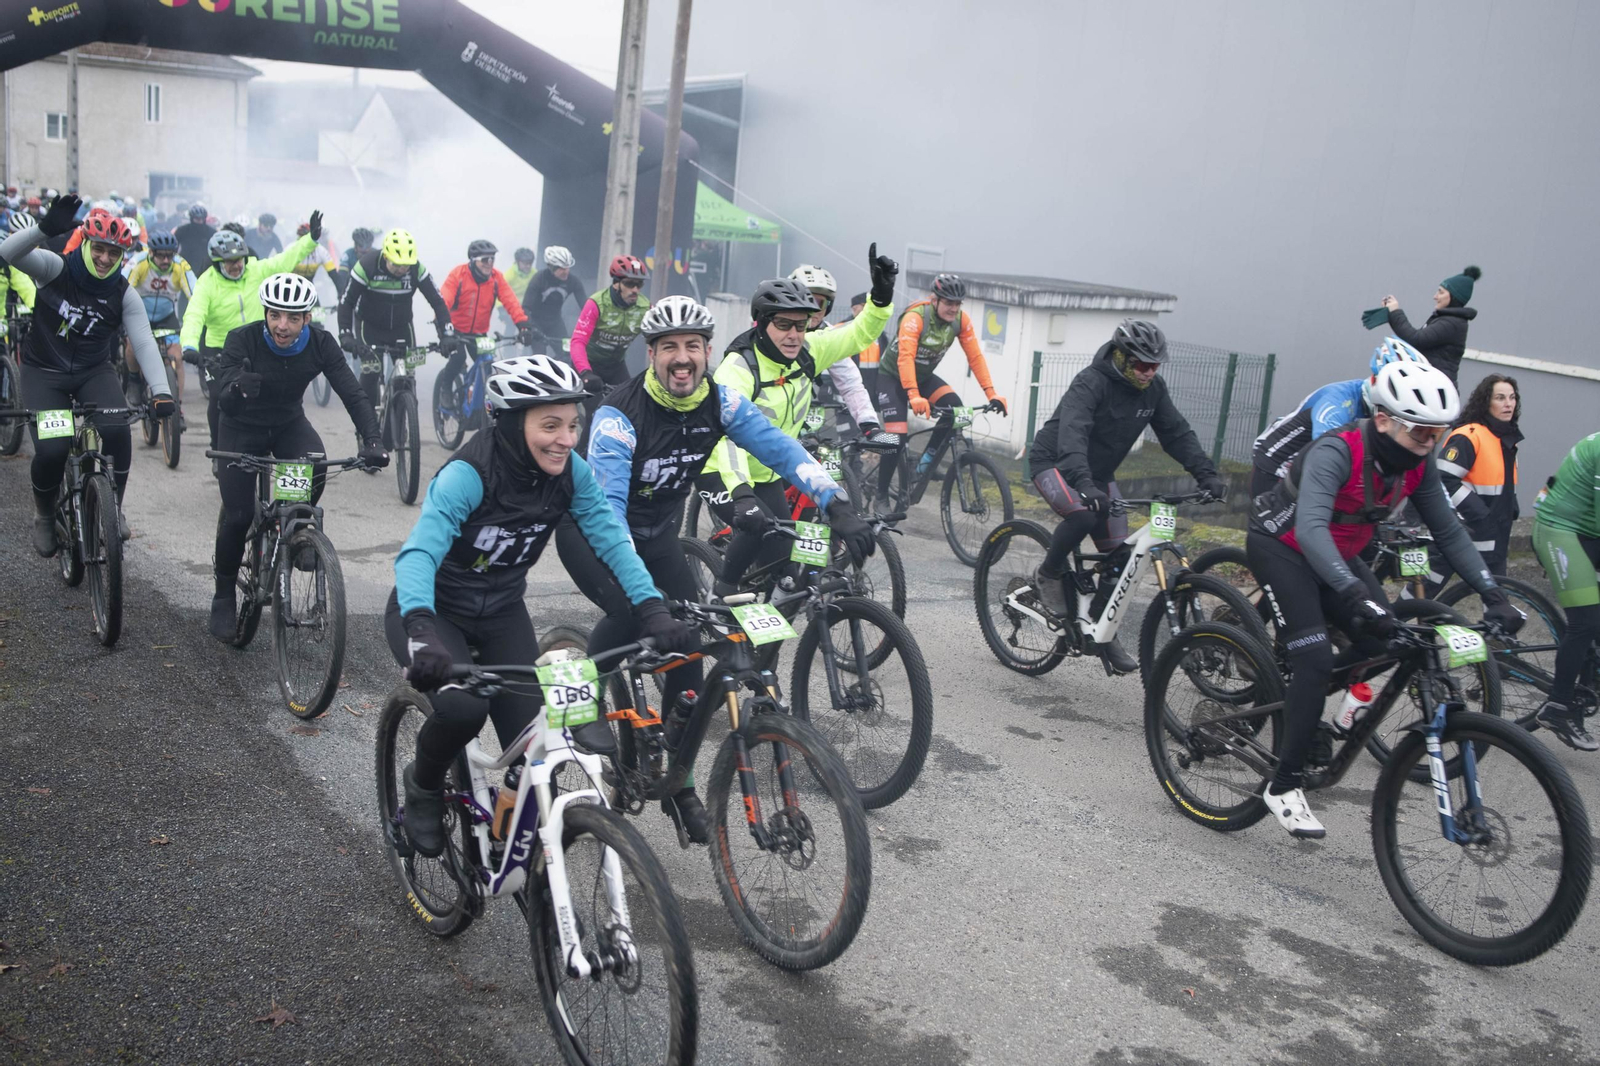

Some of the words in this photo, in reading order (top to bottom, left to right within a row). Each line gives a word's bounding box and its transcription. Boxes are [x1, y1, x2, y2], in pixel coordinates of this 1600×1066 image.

[43, 2, 79, 21] DEPORTE
[474, 59, 511, 84] OURENSE
[478, 51, 528, 83] DEPUTACIÓN
[44, 420, 67, 429] 161
[280, 478, 308, 488] 147
[800, 539, 823, 551] 110
[1404, 553, 1424, 563] 016
[1107, 553, 1144, 621] ORBEA
[1263, 584, 1287, 628] FROIZ
[748, 616, 782, 630] 159
[553, 685, 590, 705] 160
[406, 891, 434, 923] MAXXIS
